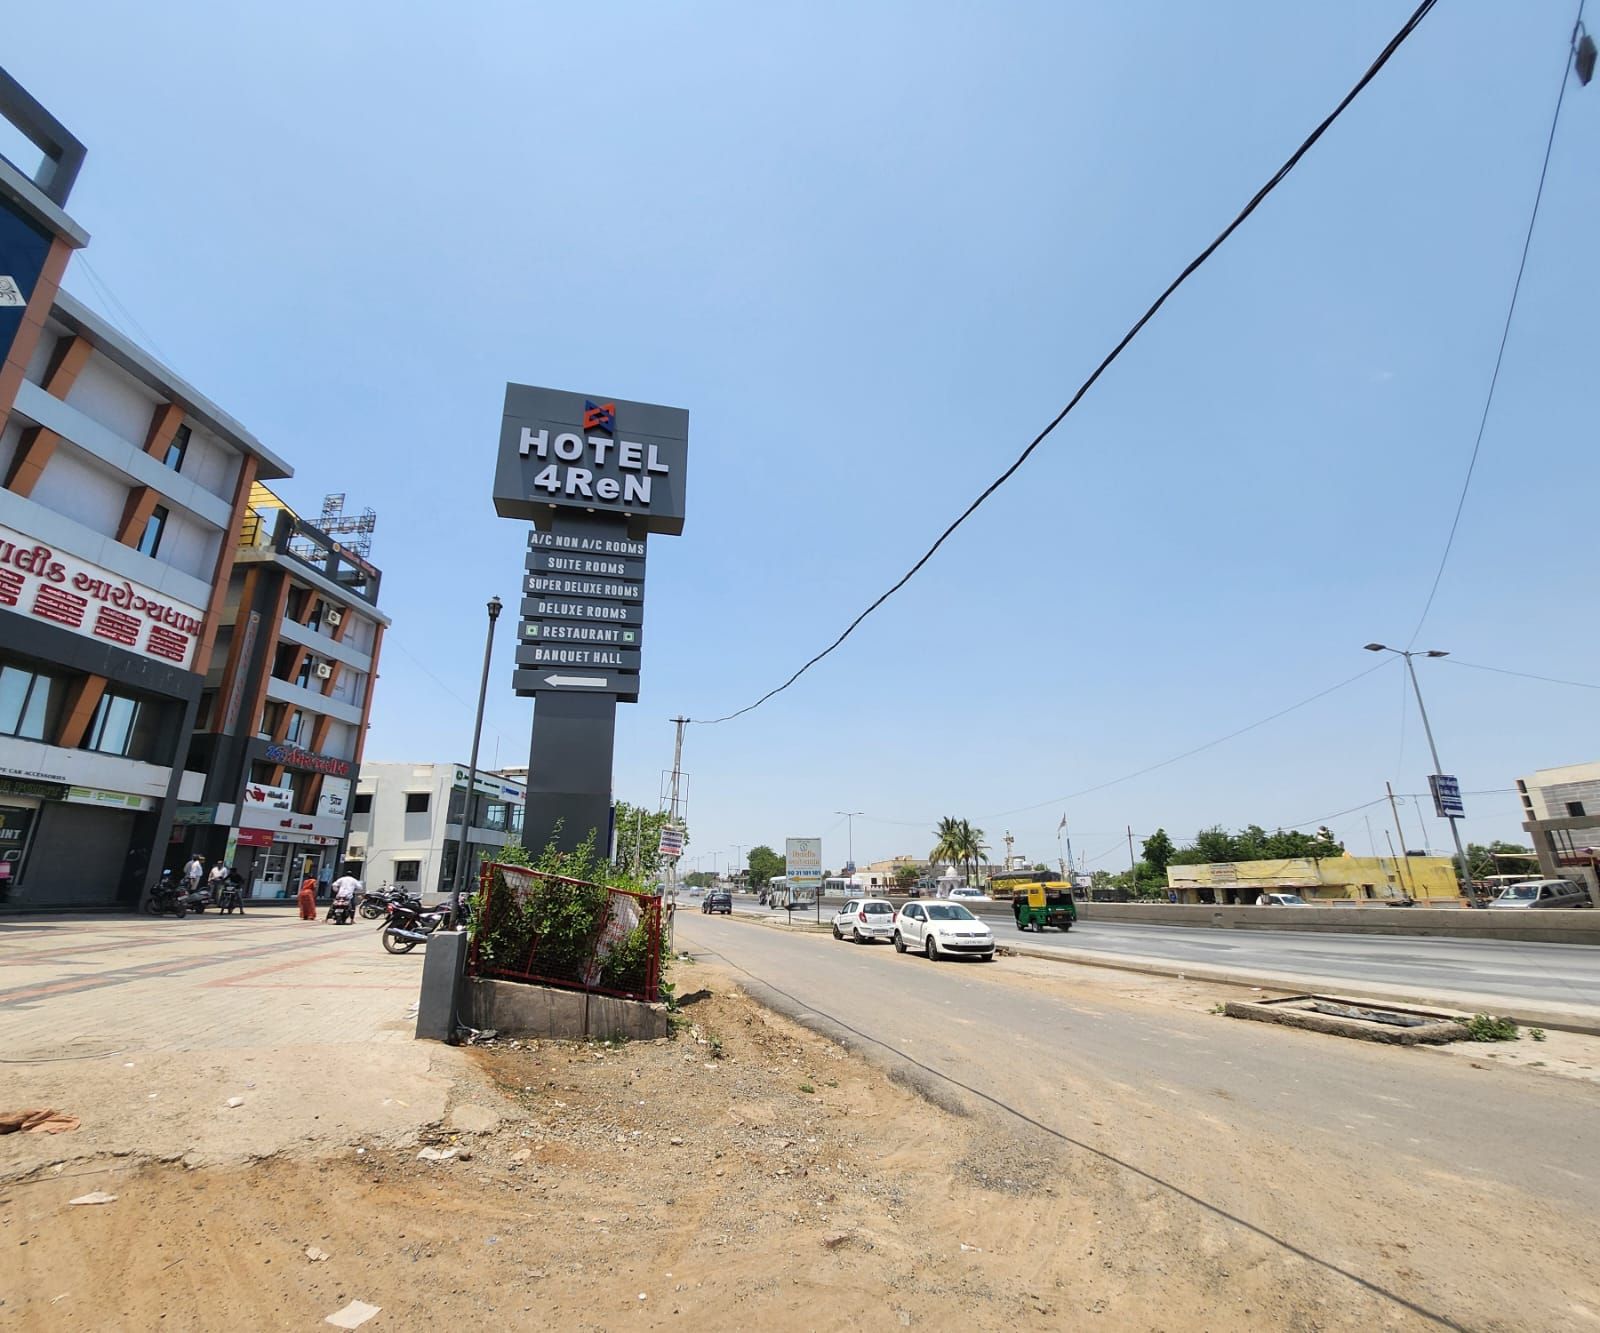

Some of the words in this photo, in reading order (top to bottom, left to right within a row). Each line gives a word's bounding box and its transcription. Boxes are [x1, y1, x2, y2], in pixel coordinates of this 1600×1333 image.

[519, 427, 670, 473] HOTEL
[534, 464, 652, 504] 4ReN
[531, 533, 553, 546] A/C
[555, 535, 579, 548] NON
[581, 538, 603, 550] A/C
[605, 541, 644, 554] ROOMS
[547, 557, 582, 570] SUITE
[585, 560, 625, 574] ROOMS
[528, 578, 561, 591] SUPER
[564, 581, 603, 594] DELUXE
[605, 583, 639, 597] ROOMS
[538, 602, 583, 616] DELUXE
[586, 606, 627, 619] ROOMS
[543, 626, 620, 641] RESTAURANT
[535, 649, 590, 663] BANQUET
[593, 651, 623, 664] HALL
[0, 828, 22, 839] INT
